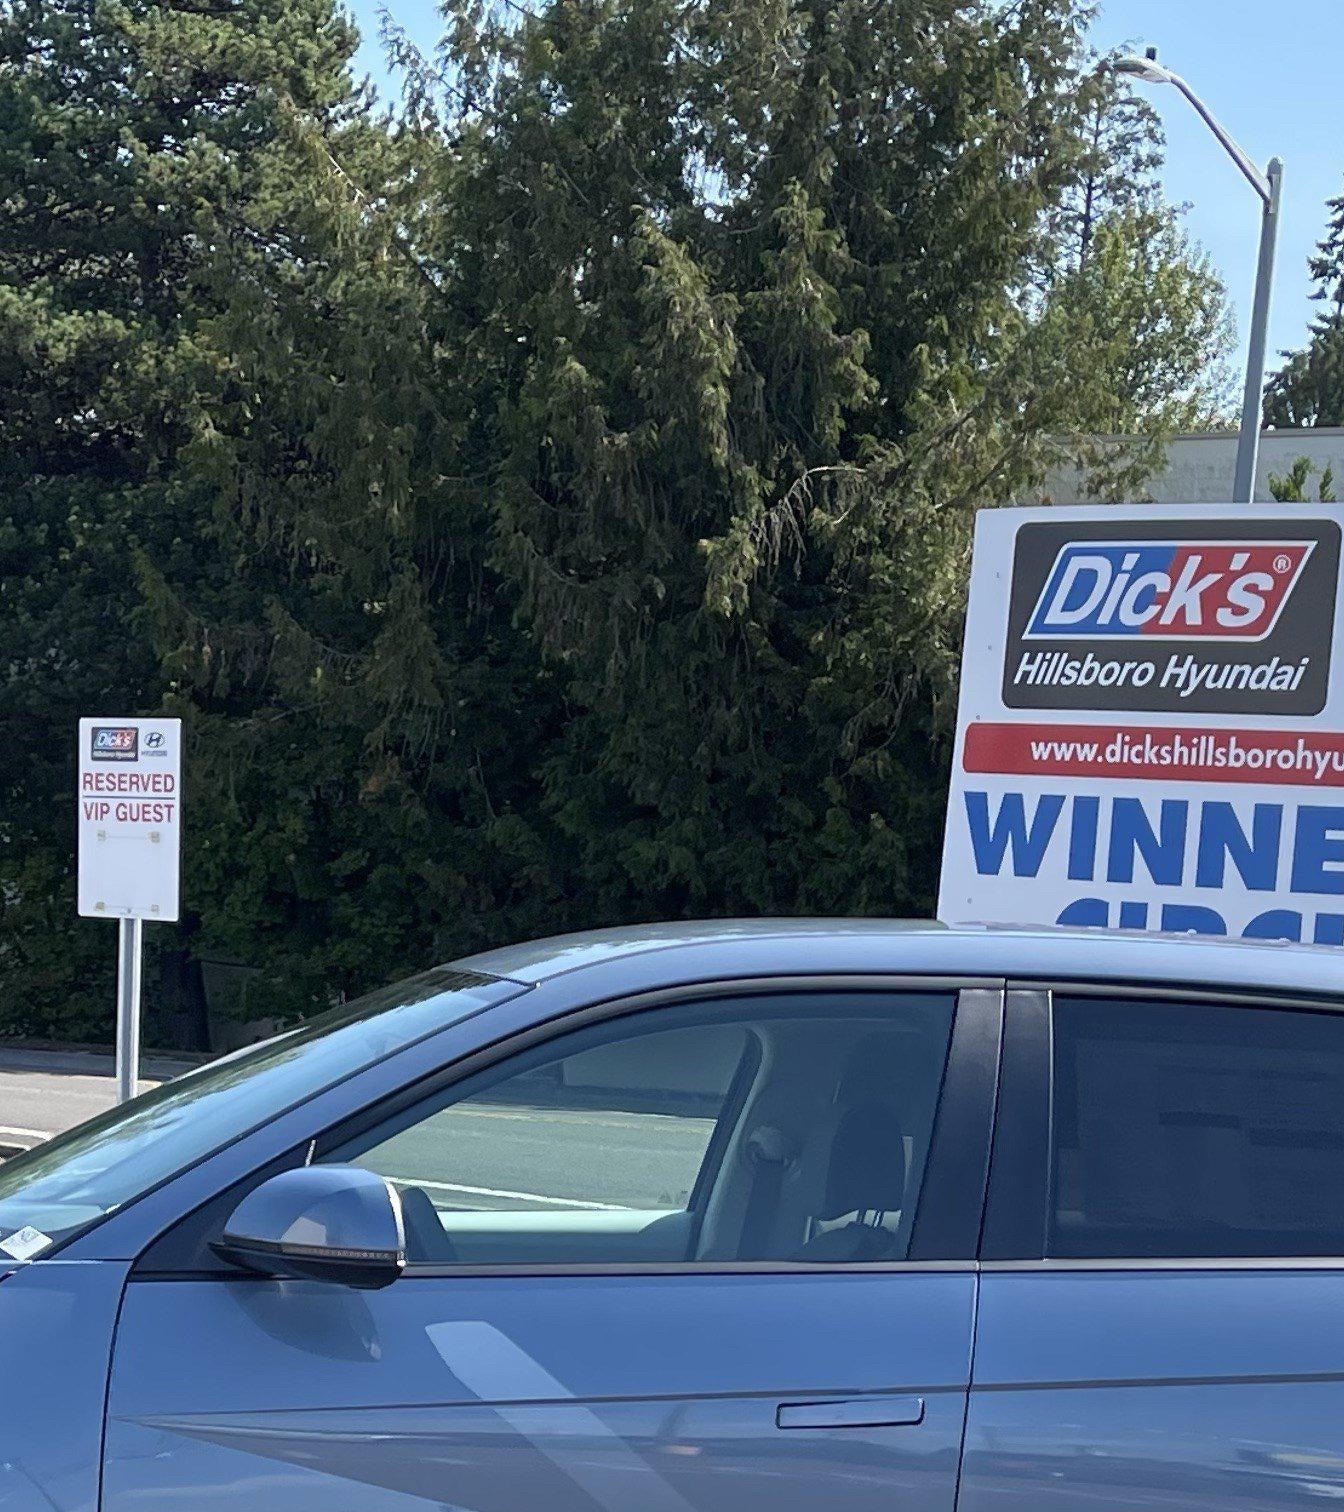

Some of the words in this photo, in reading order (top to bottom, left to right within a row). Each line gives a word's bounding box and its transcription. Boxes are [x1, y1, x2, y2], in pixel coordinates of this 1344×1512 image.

[1014, 652, 1154, 690] Hillsboro
[1159, 655, 1310, 697] Hyundai
[82, 772, 175, 793] RESERVED
[84, 802, 110, 821] VIP
[115, 802, 175, 823] GUEST
